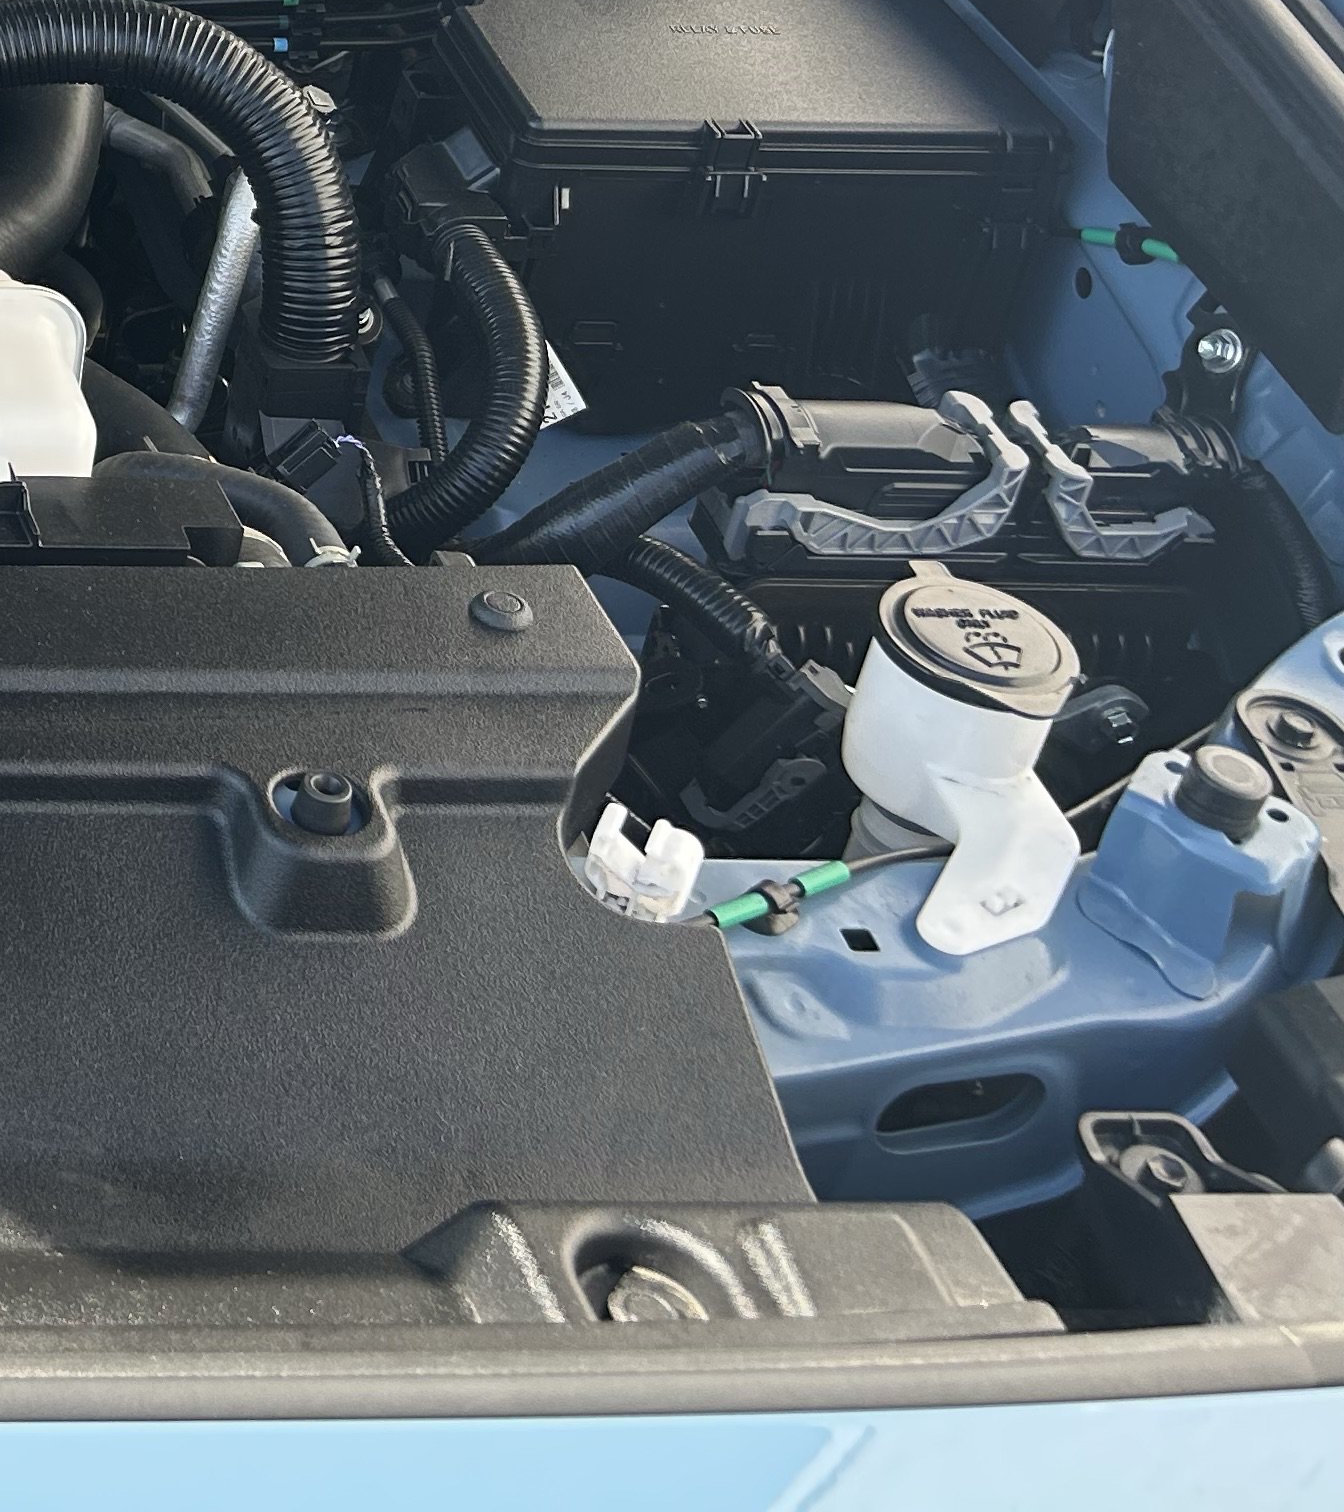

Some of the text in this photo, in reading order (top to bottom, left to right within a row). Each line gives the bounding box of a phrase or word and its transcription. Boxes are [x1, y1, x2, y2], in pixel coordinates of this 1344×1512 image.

[910, 607, 1020, 620] WASHER FLUID
[955, 618, 991, 630] ONLY
